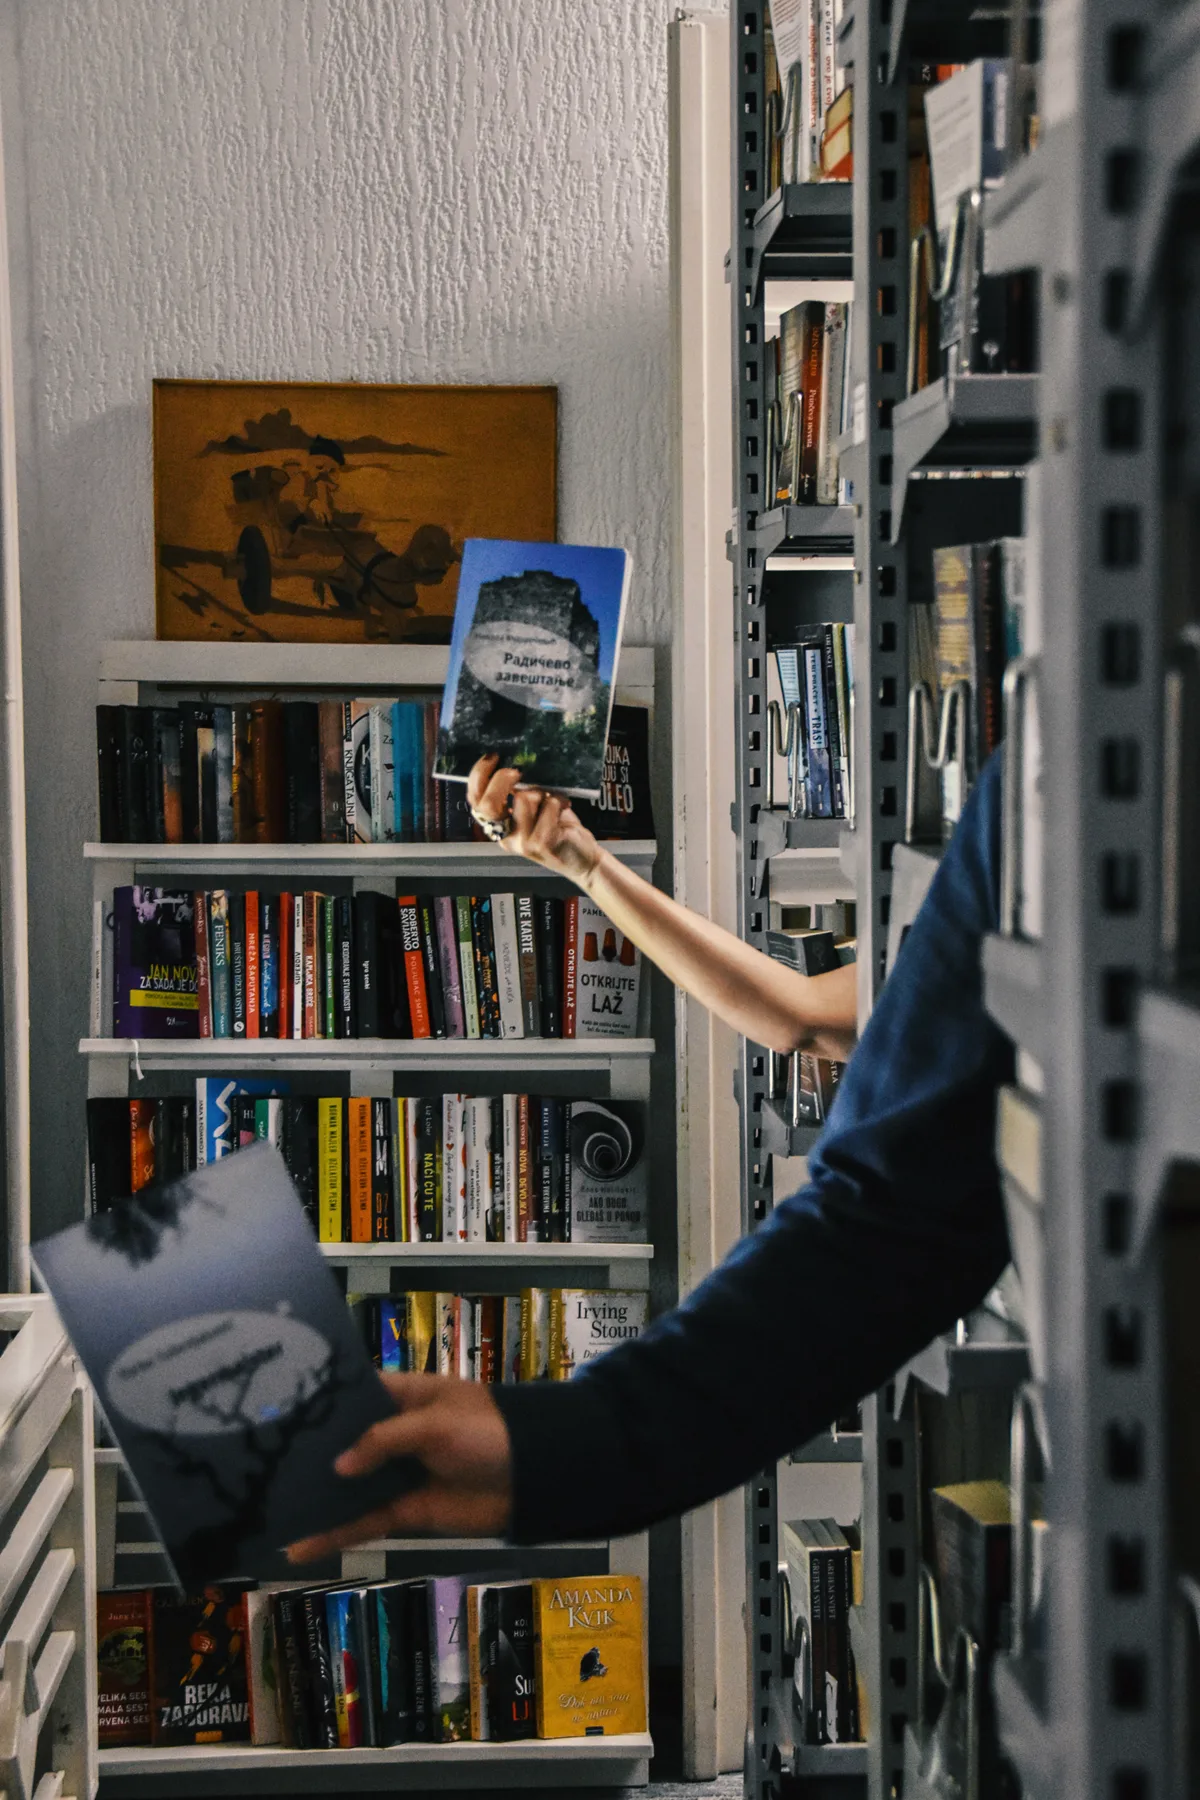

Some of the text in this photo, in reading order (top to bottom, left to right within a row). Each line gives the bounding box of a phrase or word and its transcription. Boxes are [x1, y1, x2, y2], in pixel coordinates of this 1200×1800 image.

[824, 76, 832, 85] je
[503, 652, 572, 671] Радичево
[812, 716, 822, 745] TRAS!
[590, 781, 634, 813] OLEO
[519, 897, 532, 918] DVE
[400, 908, 412, 951] SAVIJANO
[408, 908, 420, 949] ROBERTO
[520, 920, 534, 954] KARTE
[214, 925, 226, 966] FENIKS
[234, 942, 242, 974] DRUŠTVO
[140, 975, 152, 989] ZA
[153, 977, 173, 992] SADA
[149, 963, 170, 981] JAN
[248, 933, 258, 1014] MREŽA ŠAPUTANJA
[342, 941, 352, 1012] DEKODIRANJE STVARNOSTI
[580, 973, 636, 991] OTKRIJTE
[568, 991, 576, 1009] LAŽ
[591, 990, 624, 1015] LAŽ
[424, 1153, 434, 1179] NAĆI
[520, 1149, 528, 1174] NOVA
[424, 1181, 435, 1195] ĆU
[519, 1177, 528, 1216] DEVOJKA
[424, 1198, 434, 1212] TE
[576, 1301, 629, 1324] Irving
[590, 1320, 639, 1339] Stoun
[549, 1586, 633, 1610] AMANDA
[568, 1603, 620, 1632] KVIK
[185, 1682, 232, 1706] REKA
[98, 1704, 124, 1714] MALA
[160, 1702, 250, 1729] ZABORAVA
